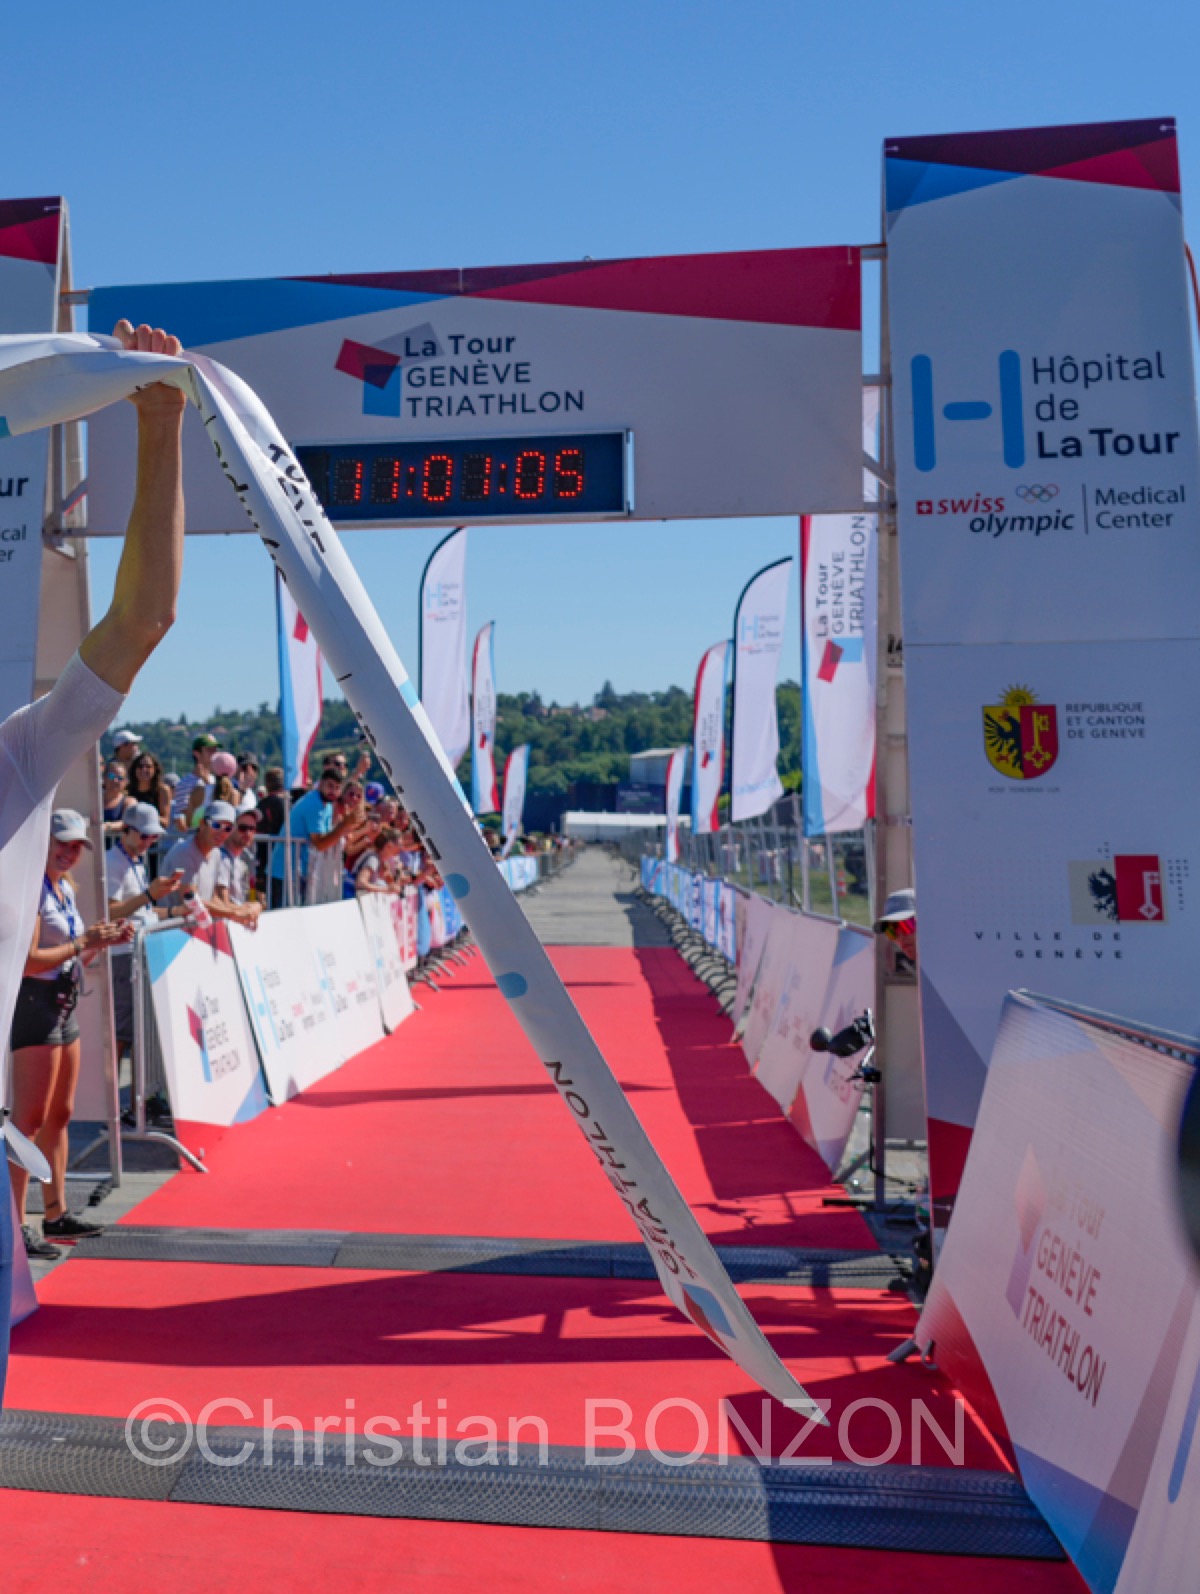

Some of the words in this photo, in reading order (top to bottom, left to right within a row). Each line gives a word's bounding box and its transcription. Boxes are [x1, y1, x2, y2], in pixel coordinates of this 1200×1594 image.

[404, 336, 437, 358] La
[448, 334, 516, 356] Tour
[406, 360, 532, 387] GENÈVE
[1032, 350, 1165, 389] Hôpital
[406, 390, 585, 418] TRIATHLON
[1035, 393, 1080, 422] de
[1037, 430, 1083, 459] La
[1088, 427, 1181, 457] Tour
[351, 448, 586, 502] 11:01:05
[937, 491, 1006, 516] swiss
[1095, 484, 1187, 506] Medical
[969, 509, 1076, 538] olympic
[1095, 511, 1174, 529] Center
[815, 563, 830, 609] Tour
[849, 514, 867, 634] TRIATHLON
[816, 613, 830, 639] La
[1067, 728, 1084, 739] DE
[1086, 715, 1146, 726] CANTON
[975, 931, 1062, 941] VILLE
[1093, 931, 1121, 941] DE
[1036, 1228, 1101, 1317] GENÈVE
[1022, 1285, 1107, 1408] TRIATHLON
